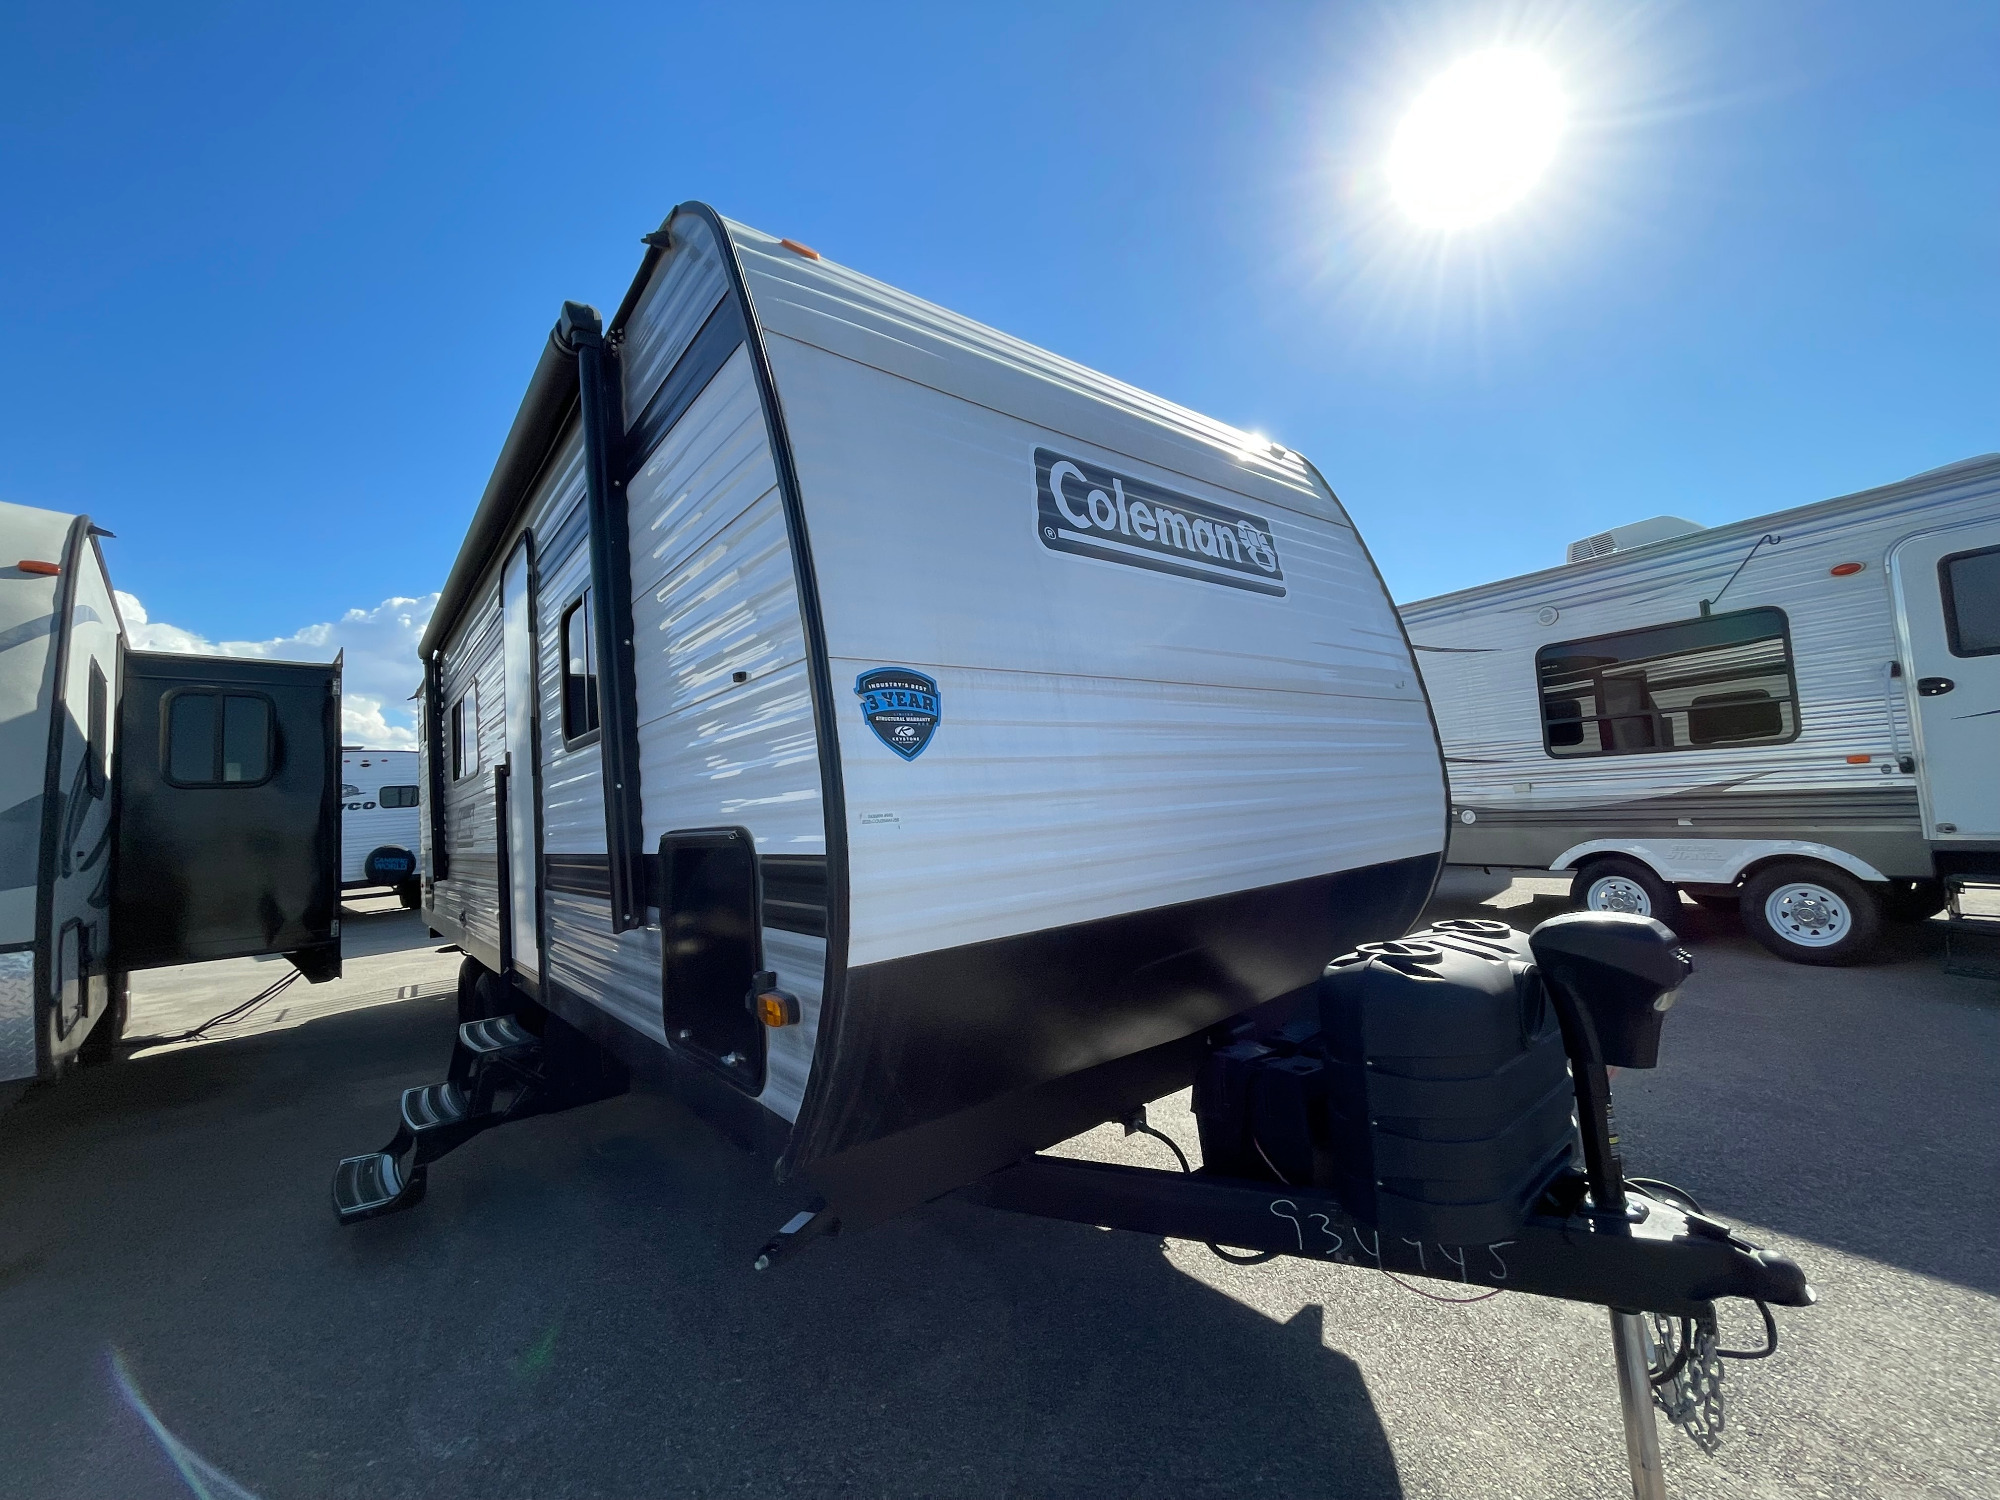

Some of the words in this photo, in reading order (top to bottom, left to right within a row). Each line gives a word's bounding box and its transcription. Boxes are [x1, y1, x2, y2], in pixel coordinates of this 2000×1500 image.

[1049, 460, 1243, 564] Coleman
[868, 682, 908, 690] INDUSTRY'S
[911, 684, 927, 692] BEST
[866, 694, 879, 711] 3
[881, 691, 935, 712] YEAR
